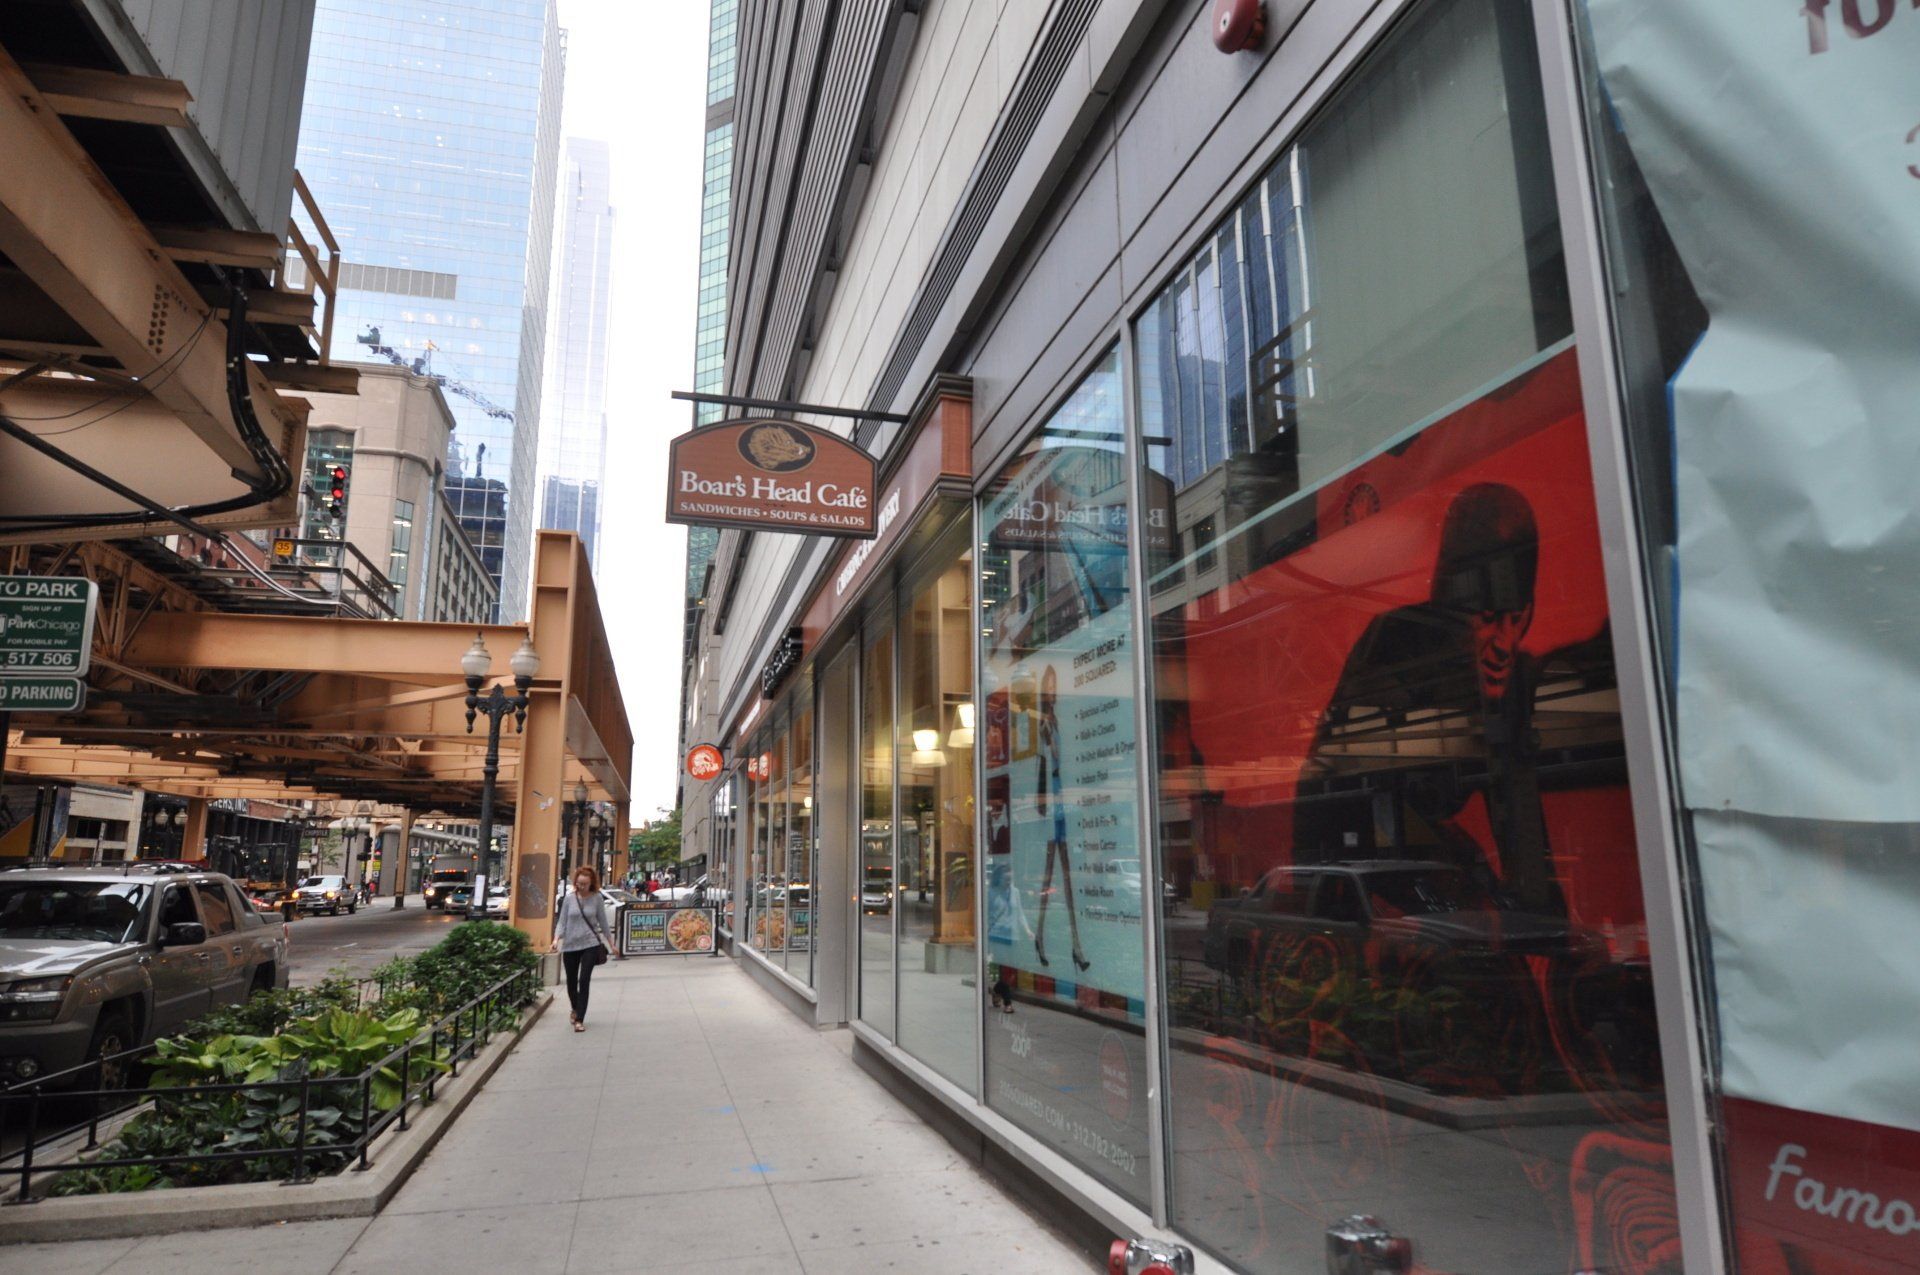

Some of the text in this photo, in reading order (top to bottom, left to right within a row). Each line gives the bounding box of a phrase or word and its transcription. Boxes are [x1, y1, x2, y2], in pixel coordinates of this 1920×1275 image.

[680, 470, 867, 508] Boar's Head Café
[680, 501, 865, 526] SANDWICHES SOUPS & SALADS
[276, 541, 291, 551] 35
[25, 582, 79, 597] PARK
[7, 617, 80, 633] ParkChicago
[24, 638, 53, 646] MOBILE
[54, 638, 69, 646] PAY
[7, 652, 73, 666] 517 506
[11, 685, 74, 700] PARKING
[631, 915, 664, 926] SMART
[1764, 1143, 1920, 1236] famo
